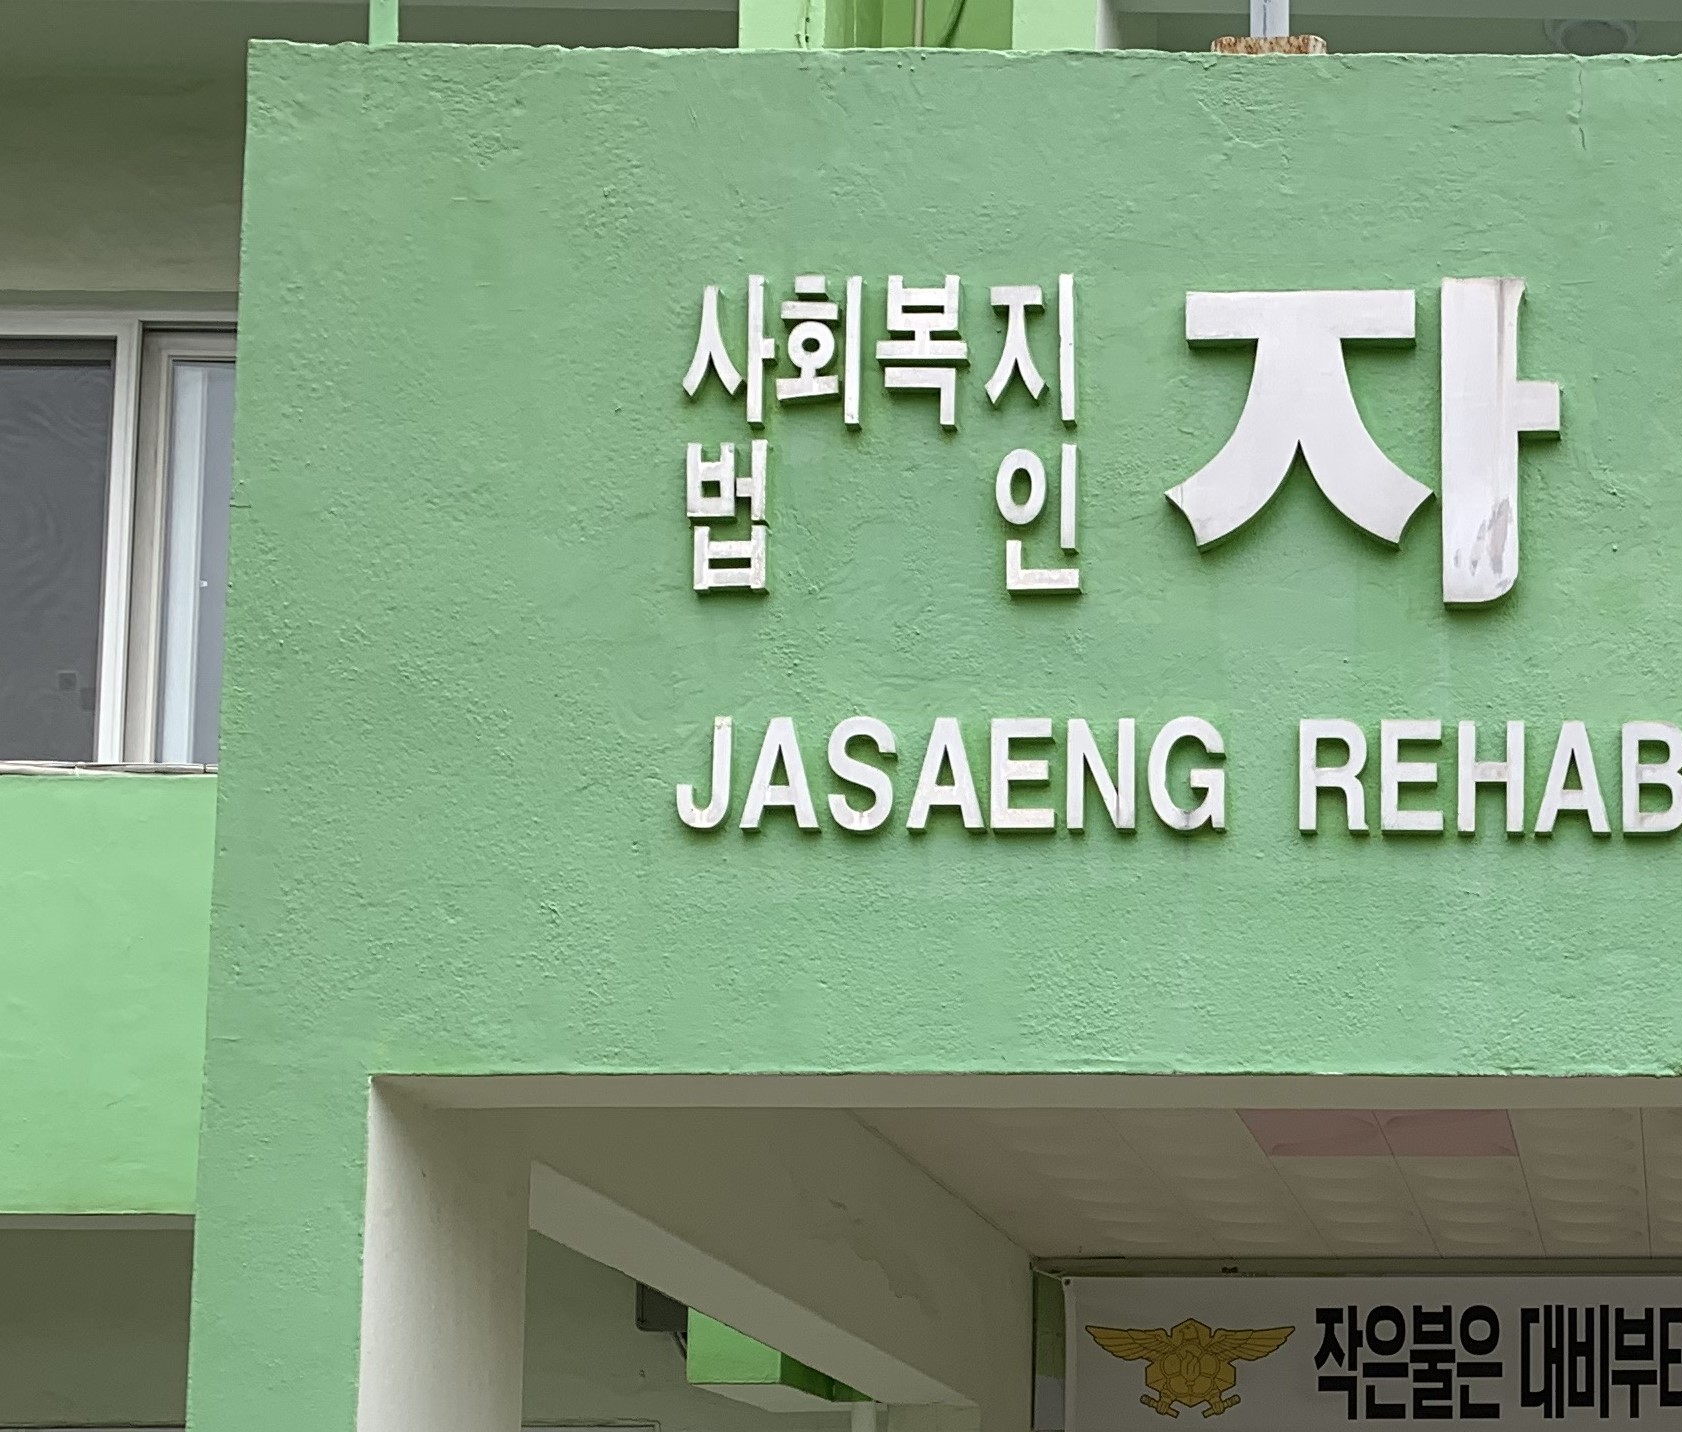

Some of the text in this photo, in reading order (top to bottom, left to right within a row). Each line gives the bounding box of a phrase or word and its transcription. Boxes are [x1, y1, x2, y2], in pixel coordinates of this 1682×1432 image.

[681, 273, 1078, 431] 사회복지
[676, 716, 1227, 833] JASAENG
[1314, 1305, 1502, 1420] 작은불은
